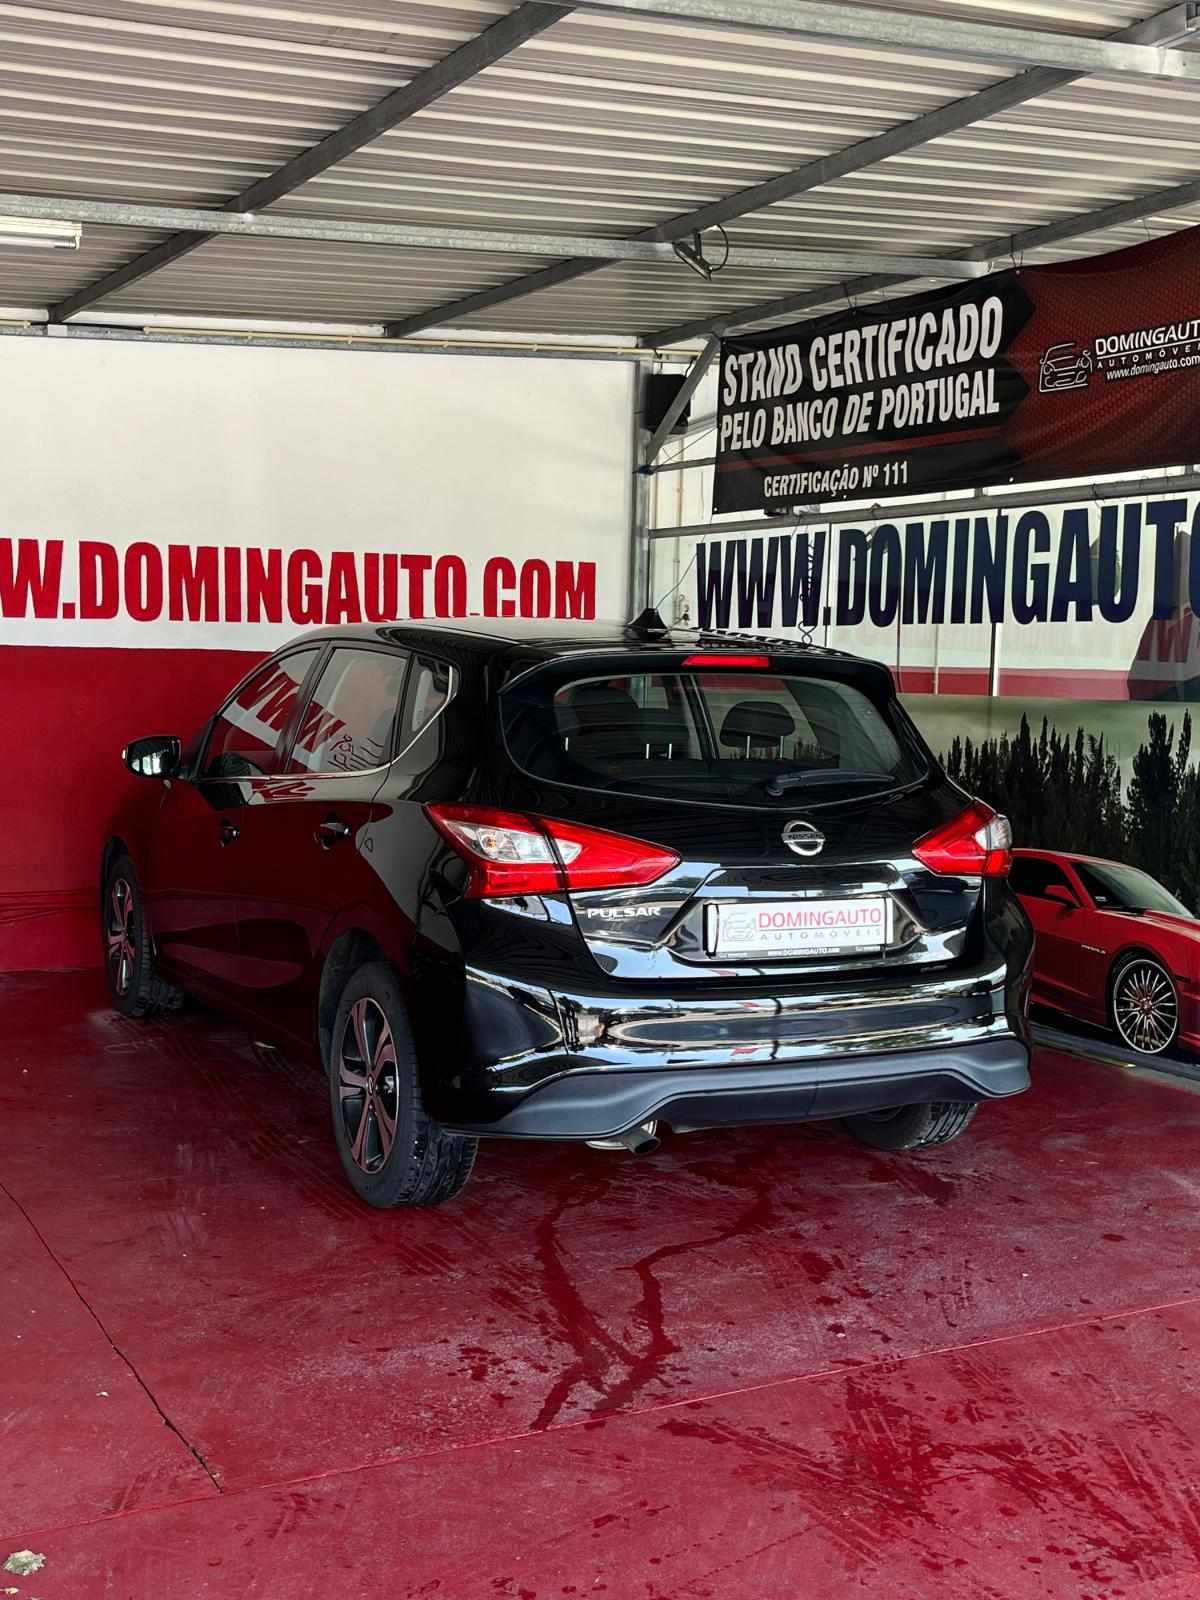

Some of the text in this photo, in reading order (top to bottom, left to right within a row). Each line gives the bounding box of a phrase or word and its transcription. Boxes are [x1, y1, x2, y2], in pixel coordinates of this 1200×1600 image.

[723, 296, 1004, 406] STAND CERTIFICADO
[720, 368, 1000, 452] PELO BANCO DE PORTUGAL
[764, 464, 859, 497] CERTIFICAÇÃO
[883, 461, 908, 484] 111
[0, 538, 596, 624] W.DOMINGAUTOCOM
[697, 499, 1200, 628] WWW.DOMINGAUT
[587, 906, 661, 919] PULSAR
[758, 908, 882, 930] DOMINGAUTO
